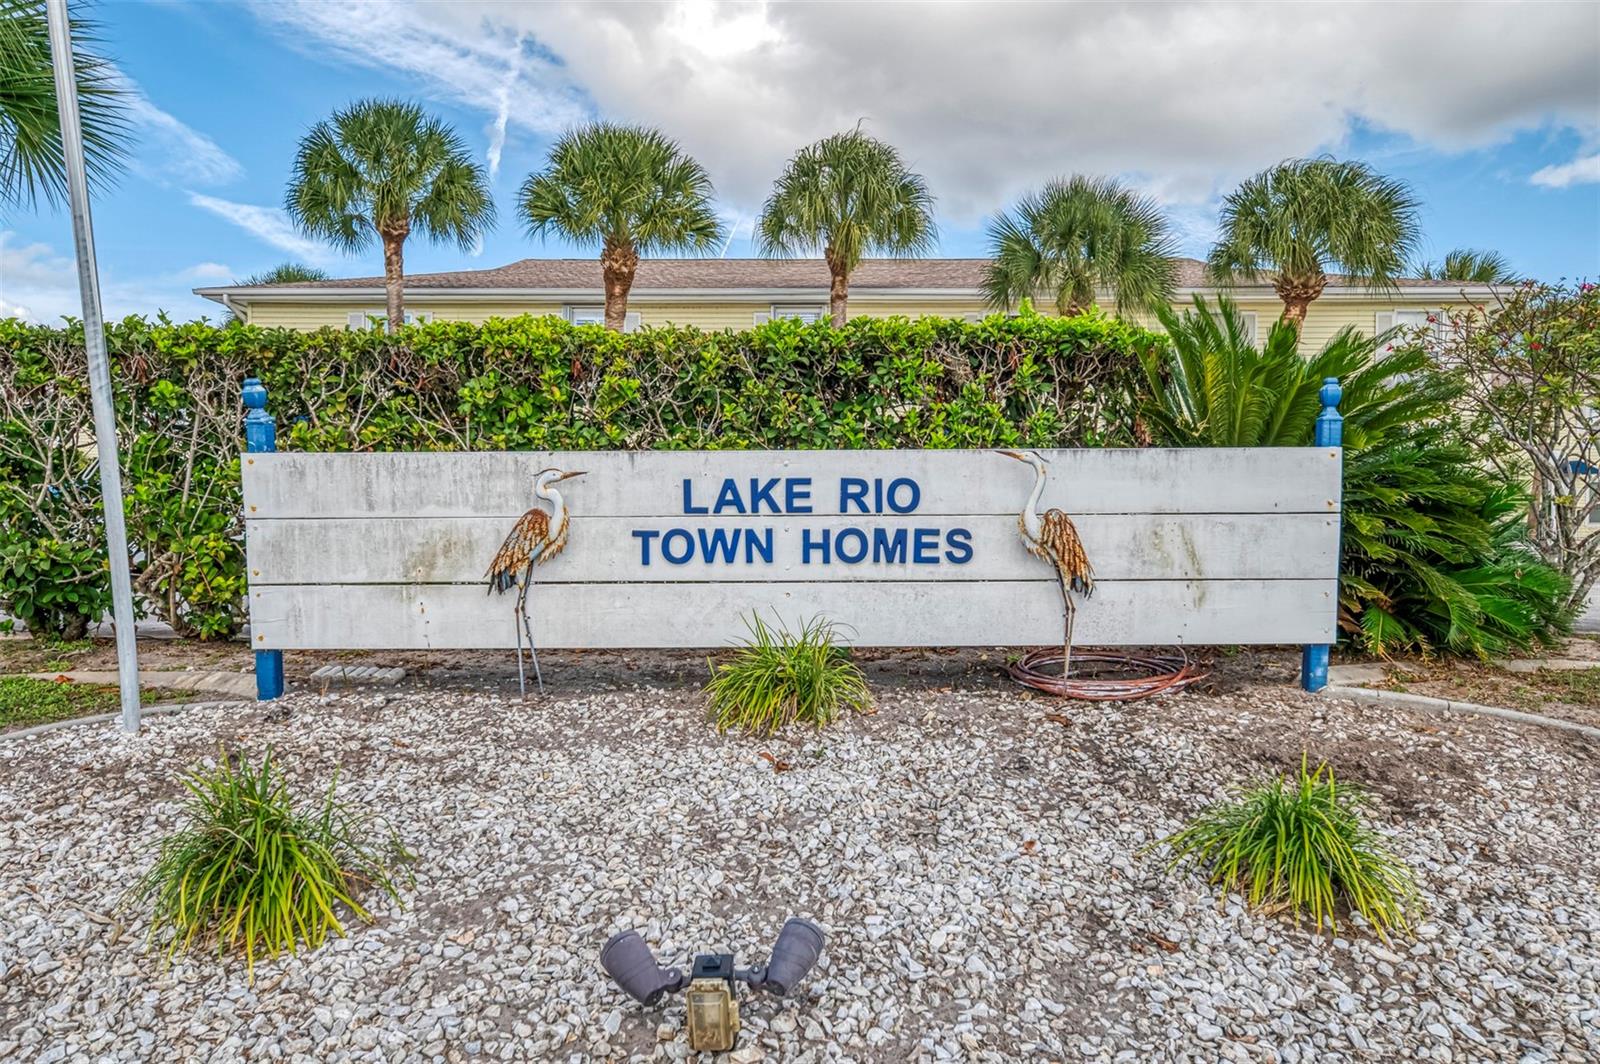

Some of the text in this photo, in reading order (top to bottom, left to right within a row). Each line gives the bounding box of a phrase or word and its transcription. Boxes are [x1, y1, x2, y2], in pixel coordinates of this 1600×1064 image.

[682, 478, 921, 514] LAKE RIO
[632, 528, 974, 566] TOWN HOMES
